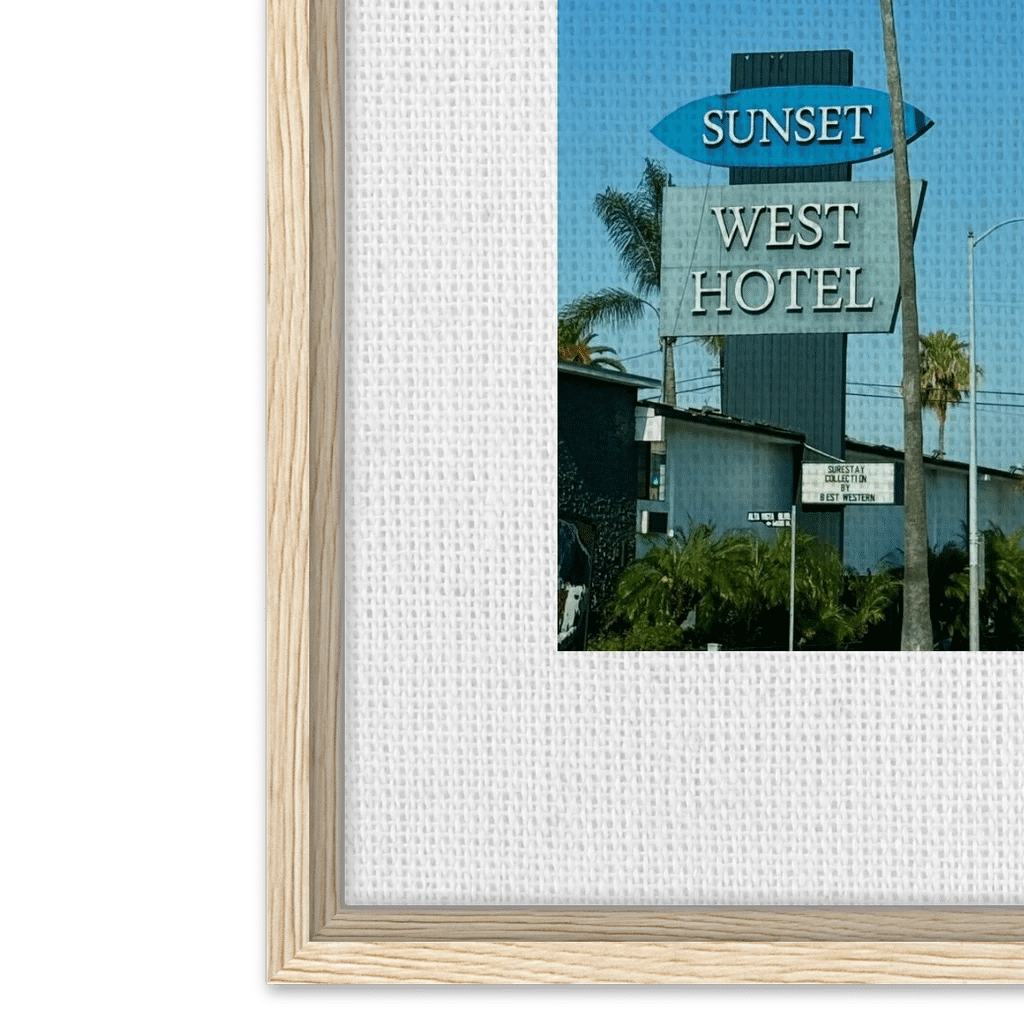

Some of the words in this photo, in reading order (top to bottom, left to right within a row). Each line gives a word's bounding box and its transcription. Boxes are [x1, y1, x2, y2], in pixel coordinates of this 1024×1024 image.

[701, 104, 874, 146] SUNSET
[710, 202, 860, 249] WEST
[690, 266, 875, 313] HOTEL
[827, 465, 865, 474] SURESTAY
[824, 474, 867, 483] COLLECTION
[840, 484, 850, 492] BY
[819, 493, 840, 502] BEST
[842, 493, 876, 502] WESTERN
